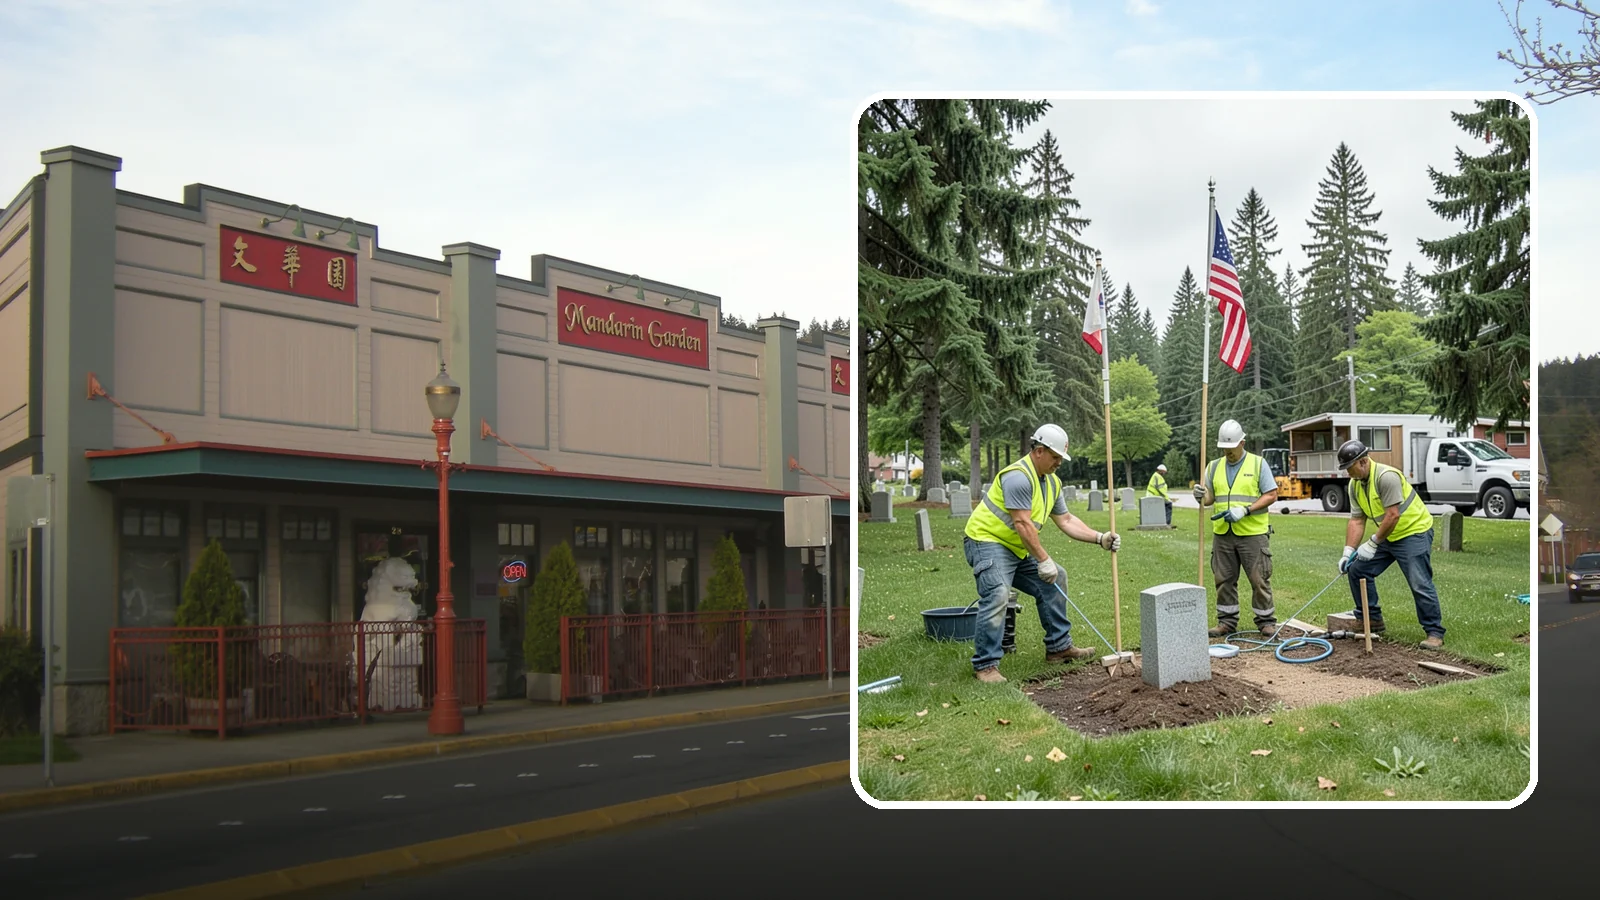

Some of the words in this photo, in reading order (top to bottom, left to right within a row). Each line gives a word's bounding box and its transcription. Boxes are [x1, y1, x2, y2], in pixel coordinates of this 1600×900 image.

[231, 236, 346, 290] 文華園
[564, 302, 643, 341] Mandarin
[648, 320, 701, 352] Garden
[503, 565, 527, 578] OPEN
